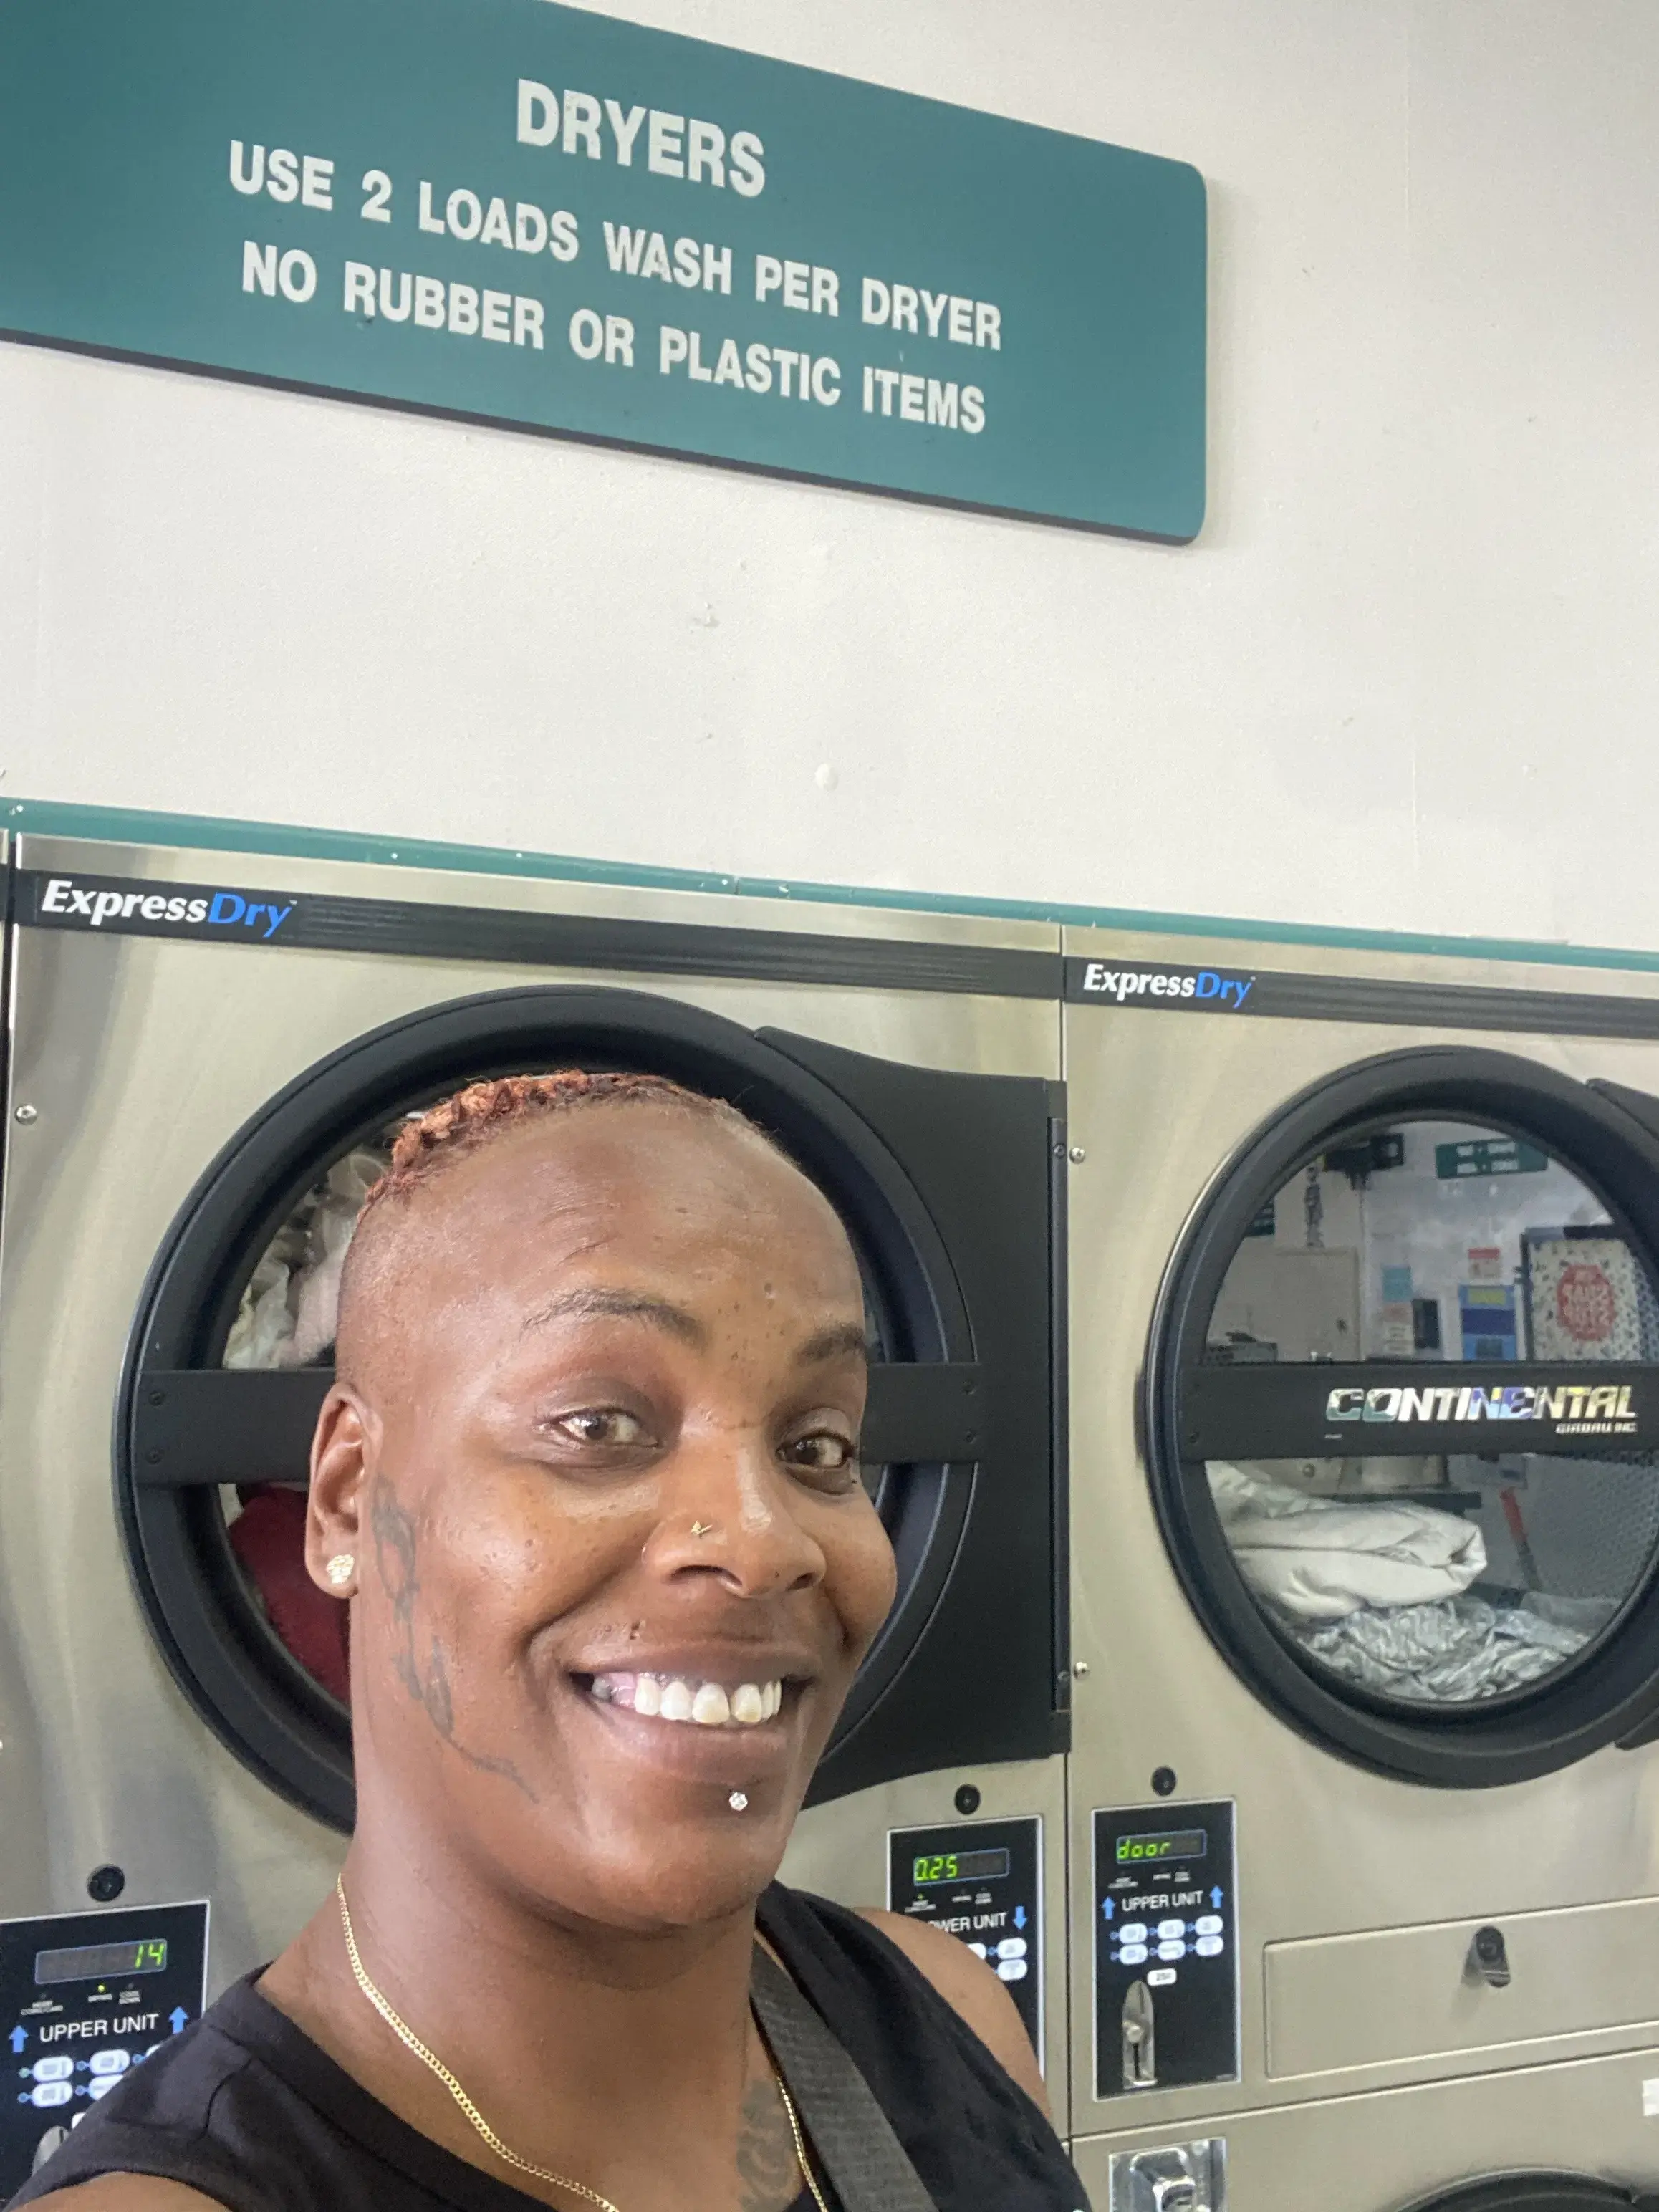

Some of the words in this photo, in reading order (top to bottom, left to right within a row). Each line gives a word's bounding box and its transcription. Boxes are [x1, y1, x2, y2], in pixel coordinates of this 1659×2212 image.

[516, 78, 765, 198] DRYERS
[230, 140, 335, 212] USE
[360, 170, 393, 223] 2
[418, 181, 580, 263] LOADS
[602, 221, 732, 295] WASH
[755, 254, 840, 317] PER
[861, 276, 1001, 351] DRYER
[242, 240, 318, 304] NO
[344, 261, 545, 350] RUBBER
[569, 308, 635, 368] OR
[659, 325, 842, 407] PLASTIC
[862, 367, 986, 434] ITEMS
[42, 879, 292, 938] ExpressDry
[1083, 963, 1253, 1009] ExpressDry
[1325, 1385, 1637, 1422] CONTINENTAL
[1117, 1837, 1171, 1860] door
[1121, 1894, 1170, 1913] UPPER
[1172, 1890, 1204, 1907] UNIT
[928, 1916, 971, 1933] WER
[973, 1911, 1008, 1930] UNIT
[135, 1942, 165, 1968] 14
[39, 2019, 107, 2043] UPPER
[113, 2013, 160, 2034] UNIT
